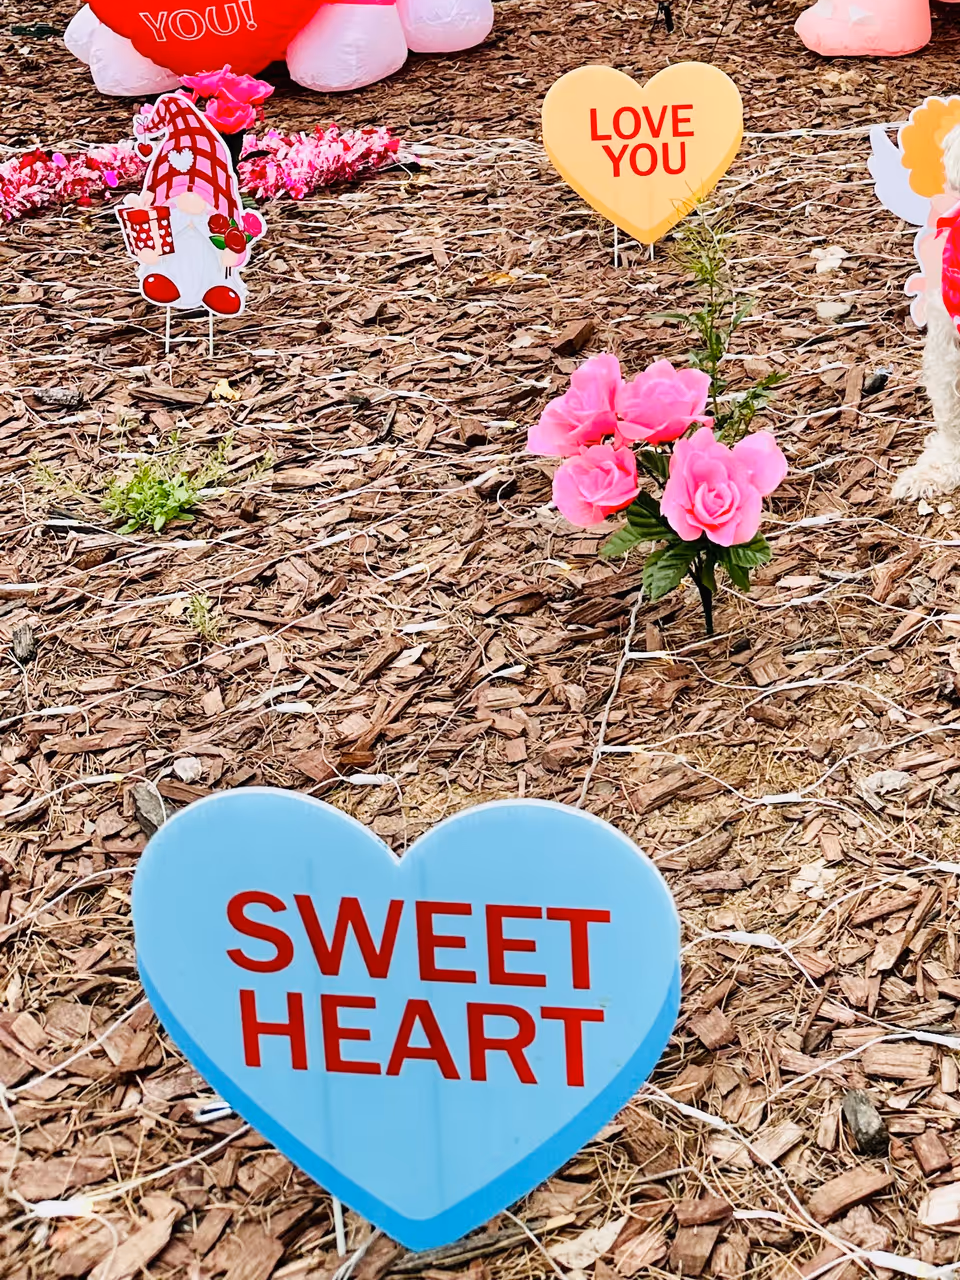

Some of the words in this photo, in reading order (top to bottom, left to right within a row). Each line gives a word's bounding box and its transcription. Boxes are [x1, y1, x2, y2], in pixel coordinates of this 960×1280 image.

[589, 104, 695, 141] LOVE
[601, 141, 687, 178] YOU
[225, 890, 611, 990] SWEET
[238, 989, 605, 1087] HEART
